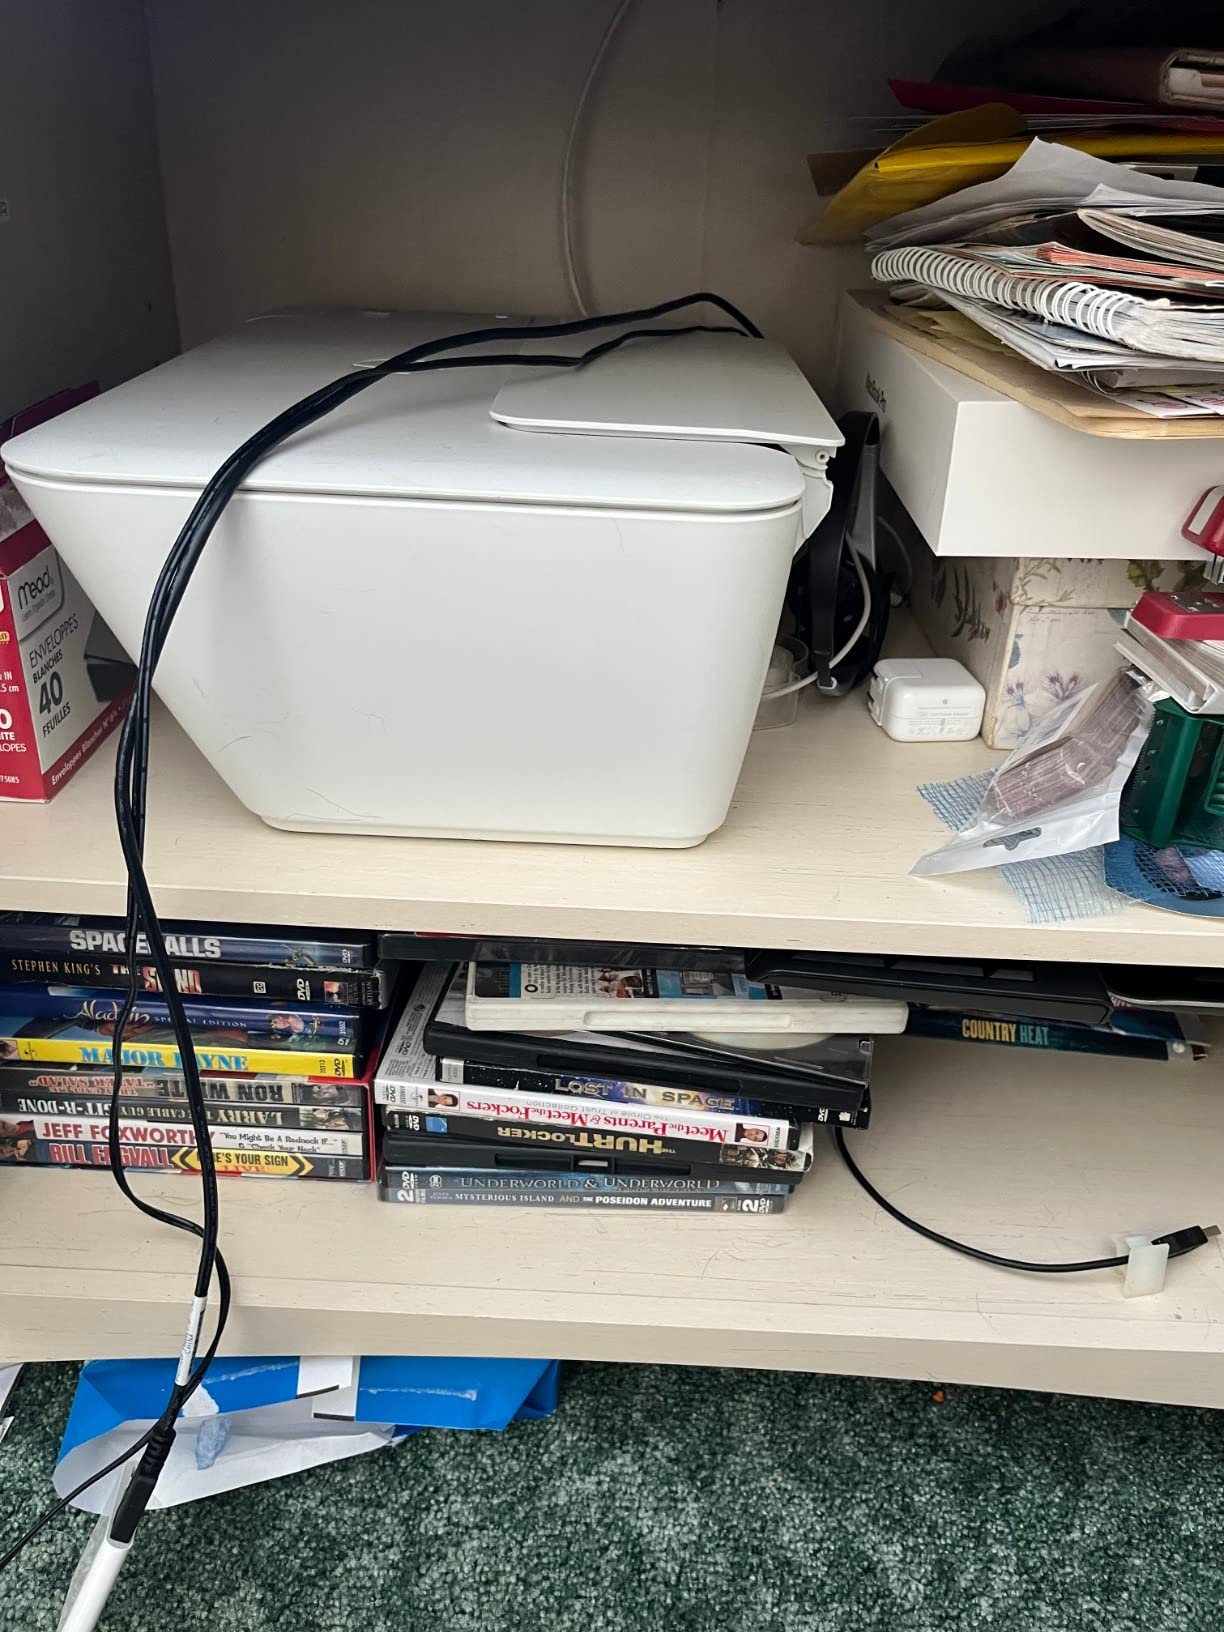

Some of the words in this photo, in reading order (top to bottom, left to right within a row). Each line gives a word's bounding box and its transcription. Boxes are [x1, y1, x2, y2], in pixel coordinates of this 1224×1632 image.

[29, 612, 79, 669] ENVELOPPES
[33, 649, 63, 684] BLANCHES
[8, 685, 20, 693] cm
[39, 671, 63, 715] 40
[42, 702, 71, 738] FEUILLES
[51, 751, 82, 786] Enveloppes
[69, 930, 221, 959] SPACEALLS
[11, 959, 59, 973] STEPHEN
[64, 962, 101, 976] KING'S
[297, 978, 307, 1000] DVD
[63, 1000, 150, 1023] Aladin
[203, 1019, 247, 1028] EDITION
[962, 1018, 1016, 1043] COUNTRY
[1019, 1025, 1049, 1046] HEAT
[333, 1058, 342, 1075] DVD
[238, 1083, 284, 1101] RON
[554, 1078, 613, 1095] LOST
[623, 1086, 647, 1099] IN
[662, 1090, 735, 1111] SPACE
[120, 1105, 145, 1116] GUY
[147, 1106, 186, 1118] CABLE
[466, 1100, 530, 1121] Fockers
[526, 1100, 578, 1112] Collection
[530, 1106, 546, 1117] the
[217, 1109, 283, 1126] LARRY
[546, 1108, 589, 1127] Meet
[590, 1114, 601, 1126] &
[604, 1114, 667, 1135] Parents
[43, 1122, 83, 1139] JEFF
[497, 1126, 577, 1143] LOCKER
[667, 1122, 685, 1133] the
[686, 1123, 728, 1143] Meet
[240, 1133, 262, 1143] Might
[286, 1136, 318, 1145] Redneck
[576, 1131, 663, 1155] HURT
[49, 1142, 91, 1164] BILL
[235, 1153, 261, 1165] YOUR
[264, 1155, 288, 1167] SIGN
[402, 1171, 410, 1189] DVD
[461, 1177, 579, 1189] UNDERWORLD
[584, 1178, 597, 1189] &
[604, 1177, 720, 1189] UNDERWORLD
[397, 1189, 415, 1202] 2
[455, 1193, 517, 1202] MYSTERIOUS
[520, 1194, 555, 1202] ISLAND
[560, 1195, 580, 1203] AND
[595, 1195, 648, 1206] POSEIDON
[651, 1197, 712, 1207] ADVENTURE
[742, 1199, 759, 1213] 2
